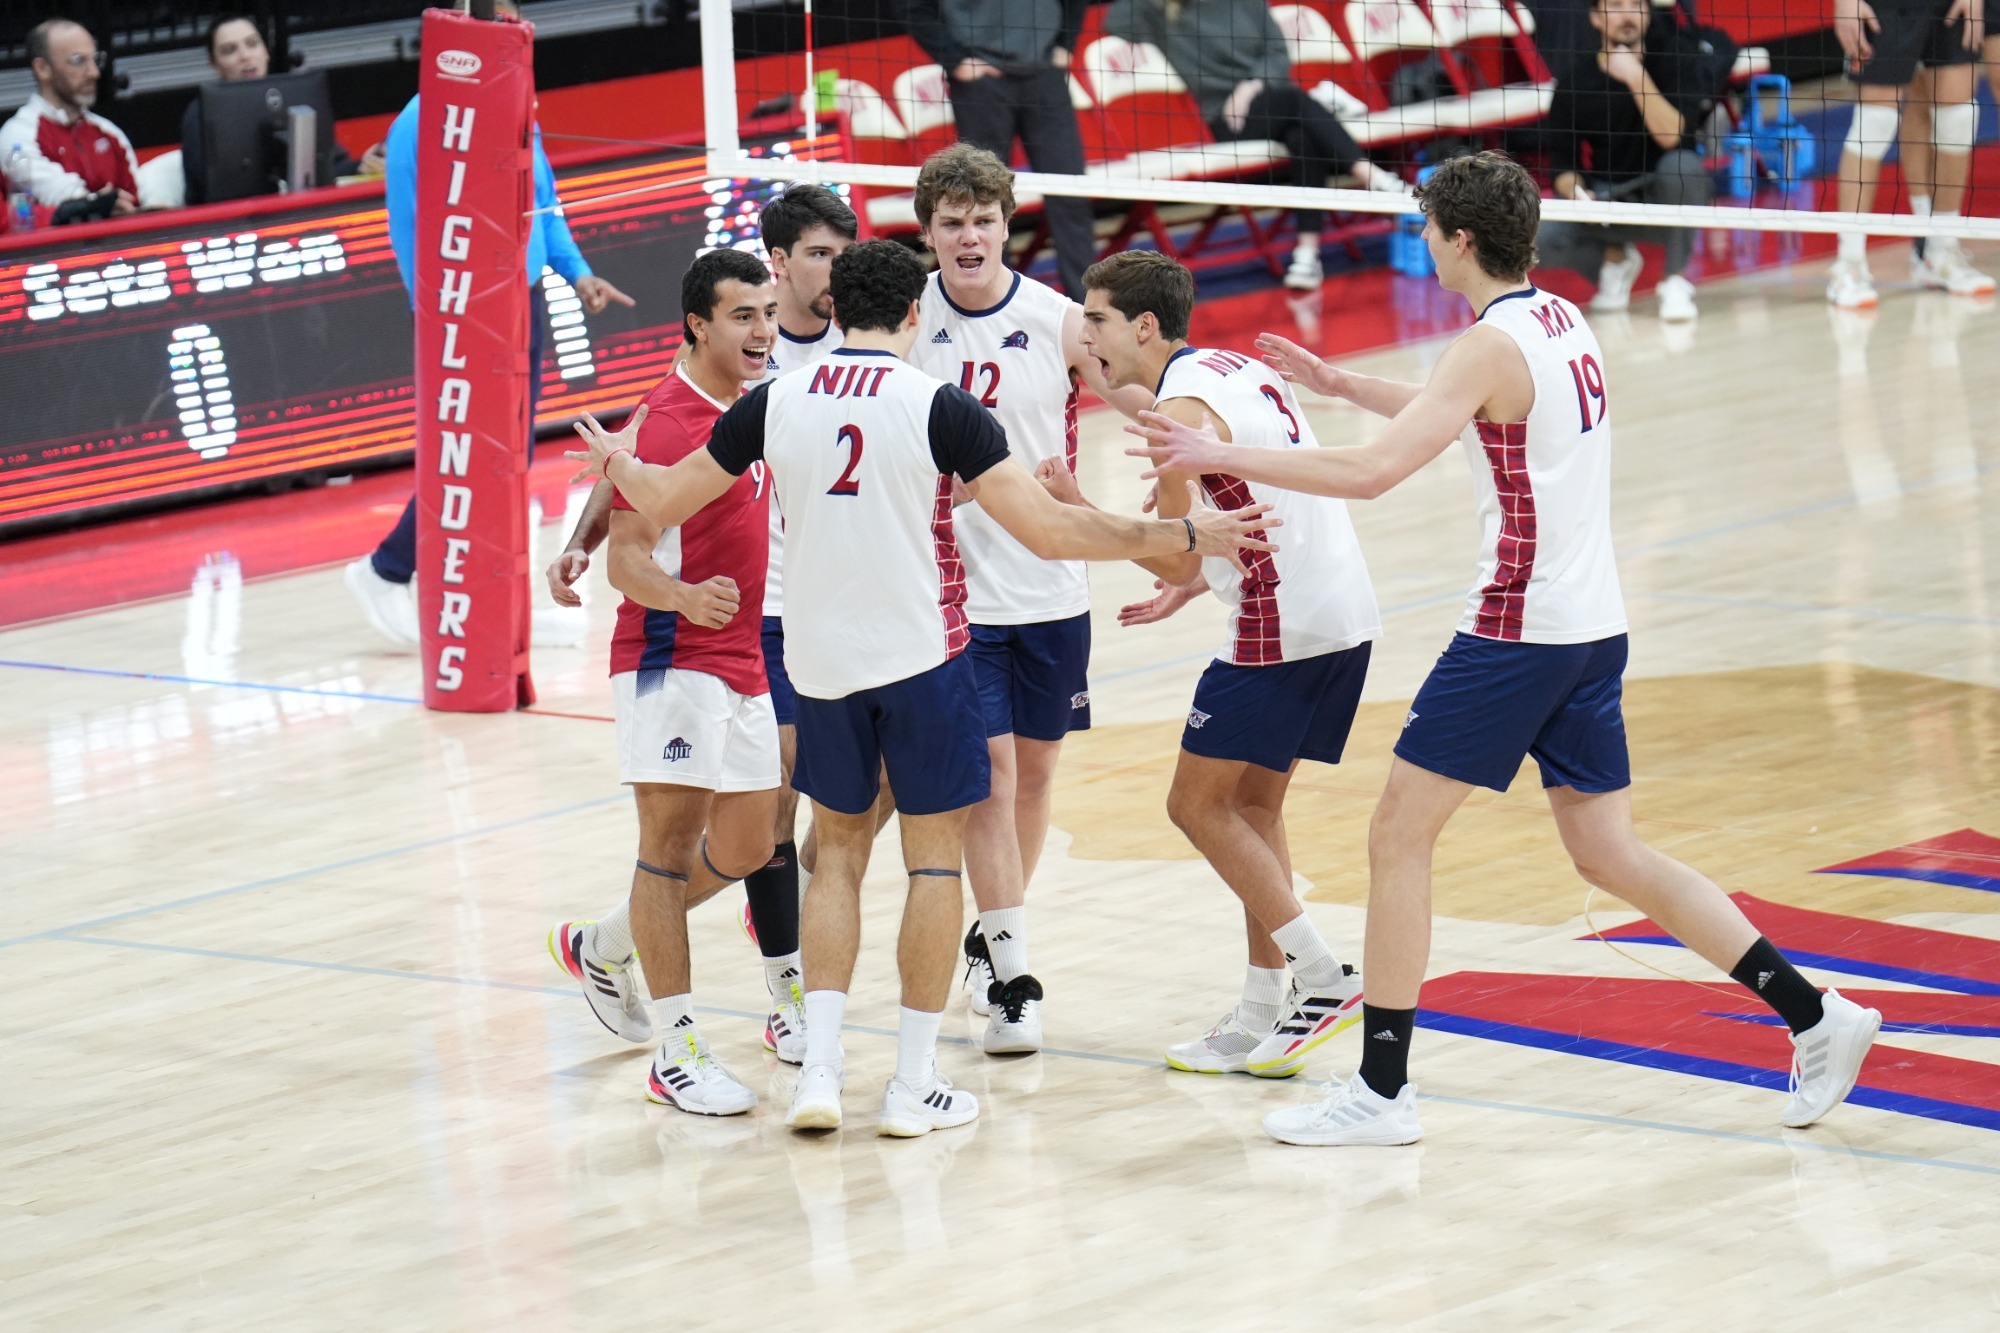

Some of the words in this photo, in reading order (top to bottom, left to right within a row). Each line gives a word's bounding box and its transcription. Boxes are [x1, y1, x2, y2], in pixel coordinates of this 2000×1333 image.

[931, 337, 952, 345] adidas
[436, 103, 476, 692] HIGHLANDERS
[807, 365, 895, 399] NJIT
[960, 361, 1001, 409] 12
[1568, 353, 1606, 434] 19
[1259, 384, 1300, 444] 3
[749, 459, 765, 501] 9
[826, 423, 864, 496] 2
[663, 746, 692, 763] NJIT
